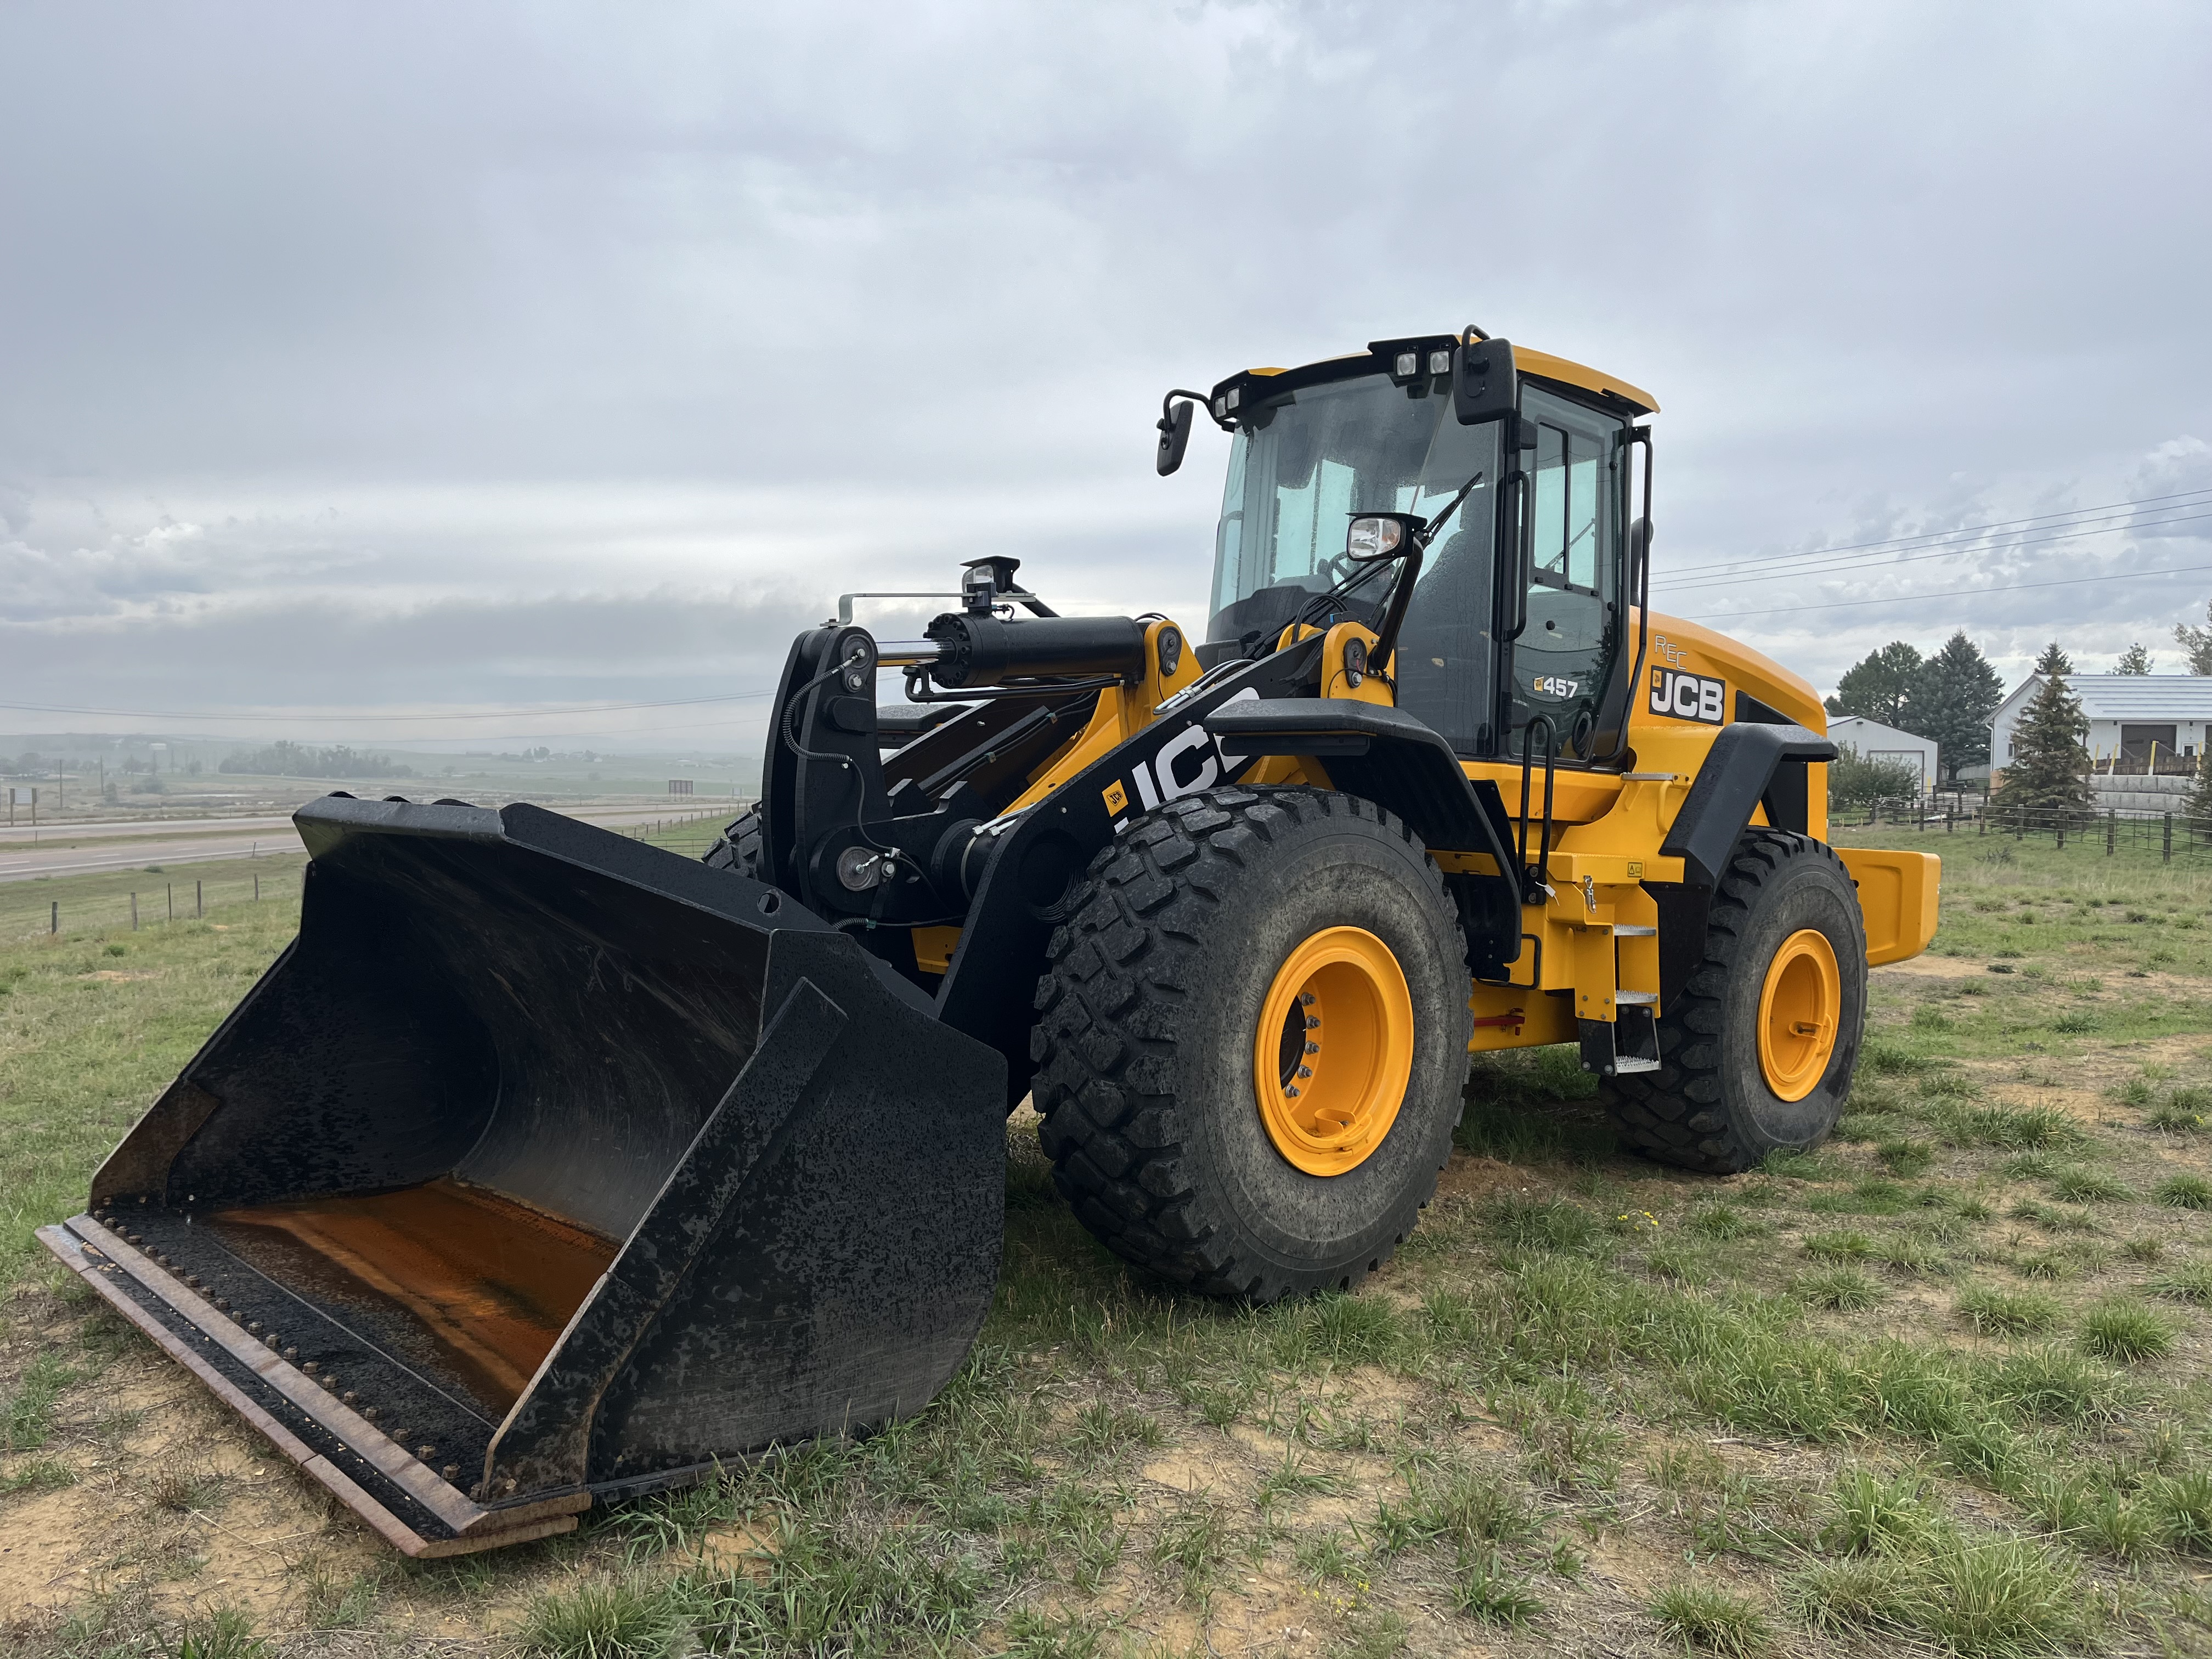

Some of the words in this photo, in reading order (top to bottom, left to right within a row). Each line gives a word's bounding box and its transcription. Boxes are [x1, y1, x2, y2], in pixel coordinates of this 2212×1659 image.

[1655, 635, 1688, 670] REC
[1543, 676, 1578, 698] 457
[1651, 672, 1723, 721] JCB
[1109, 792, 1122, 804] JCB
